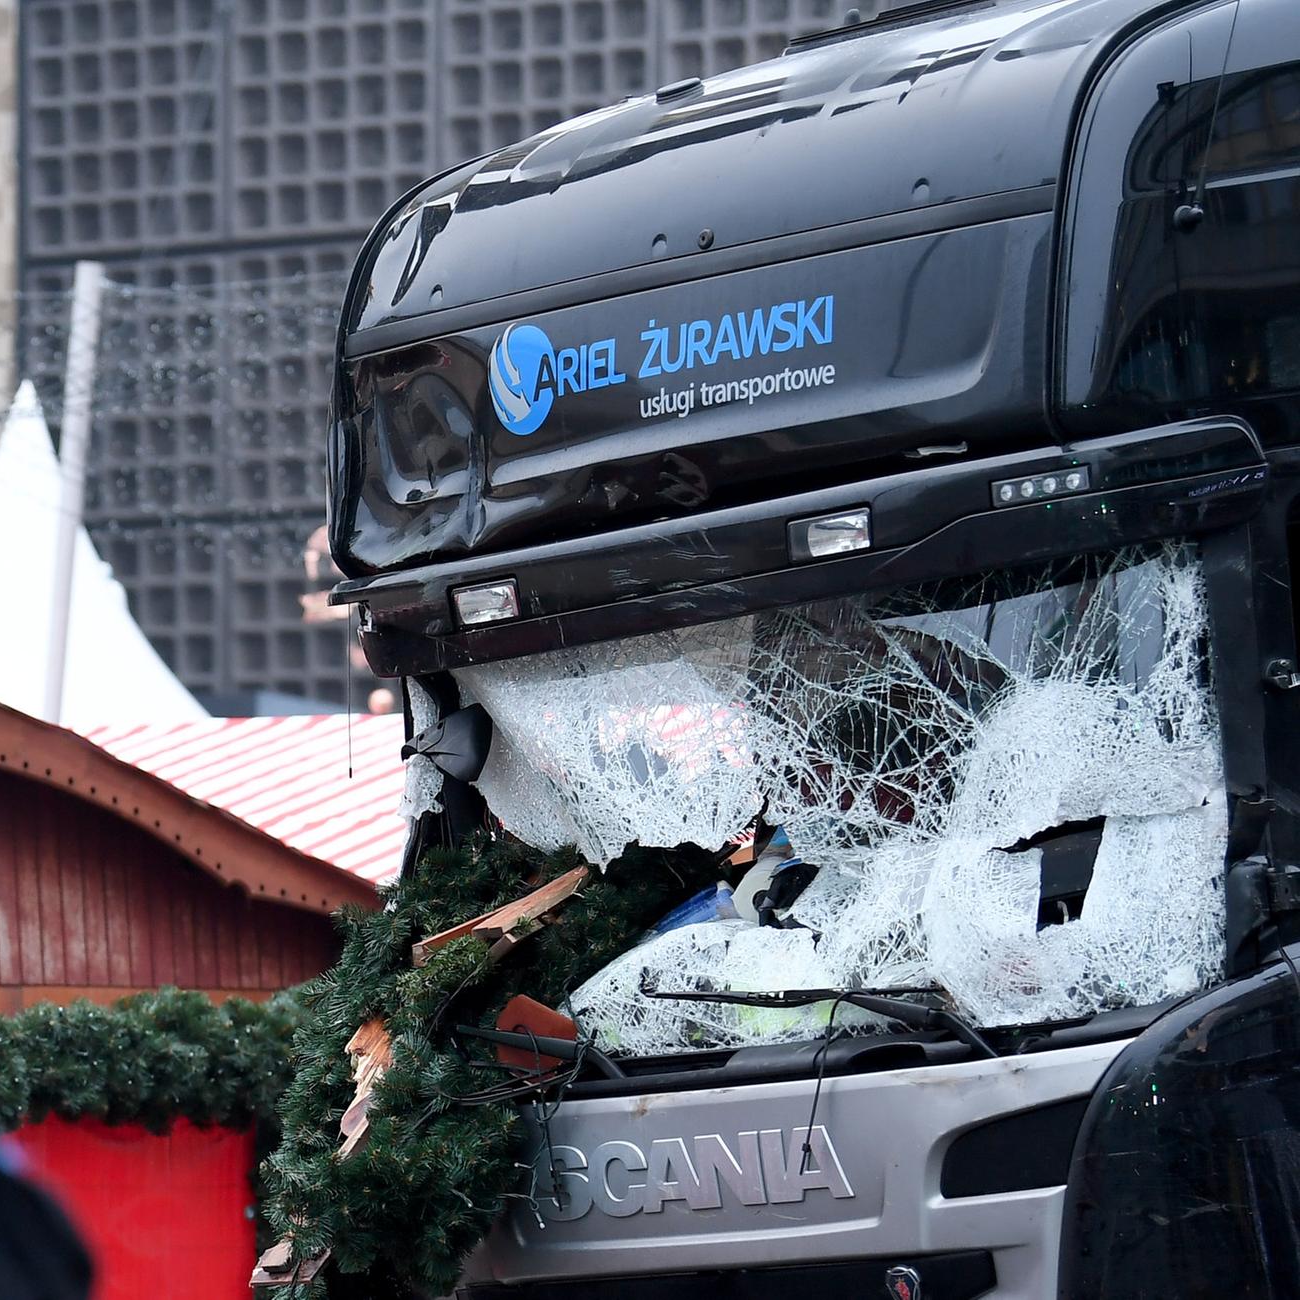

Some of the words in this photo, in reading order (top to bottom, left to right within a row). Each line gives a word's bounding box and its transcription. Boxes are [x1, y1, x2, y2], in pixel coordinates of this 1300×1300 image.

[533, 337, 626, 402] ARIEL
[638, 295, 835, 378] ŻURAWSKI
[639, 387, 695, 419] usługi
[700, 362, 836, 405] transportowe
[535, 1125, 855, 1222] SCANIA
